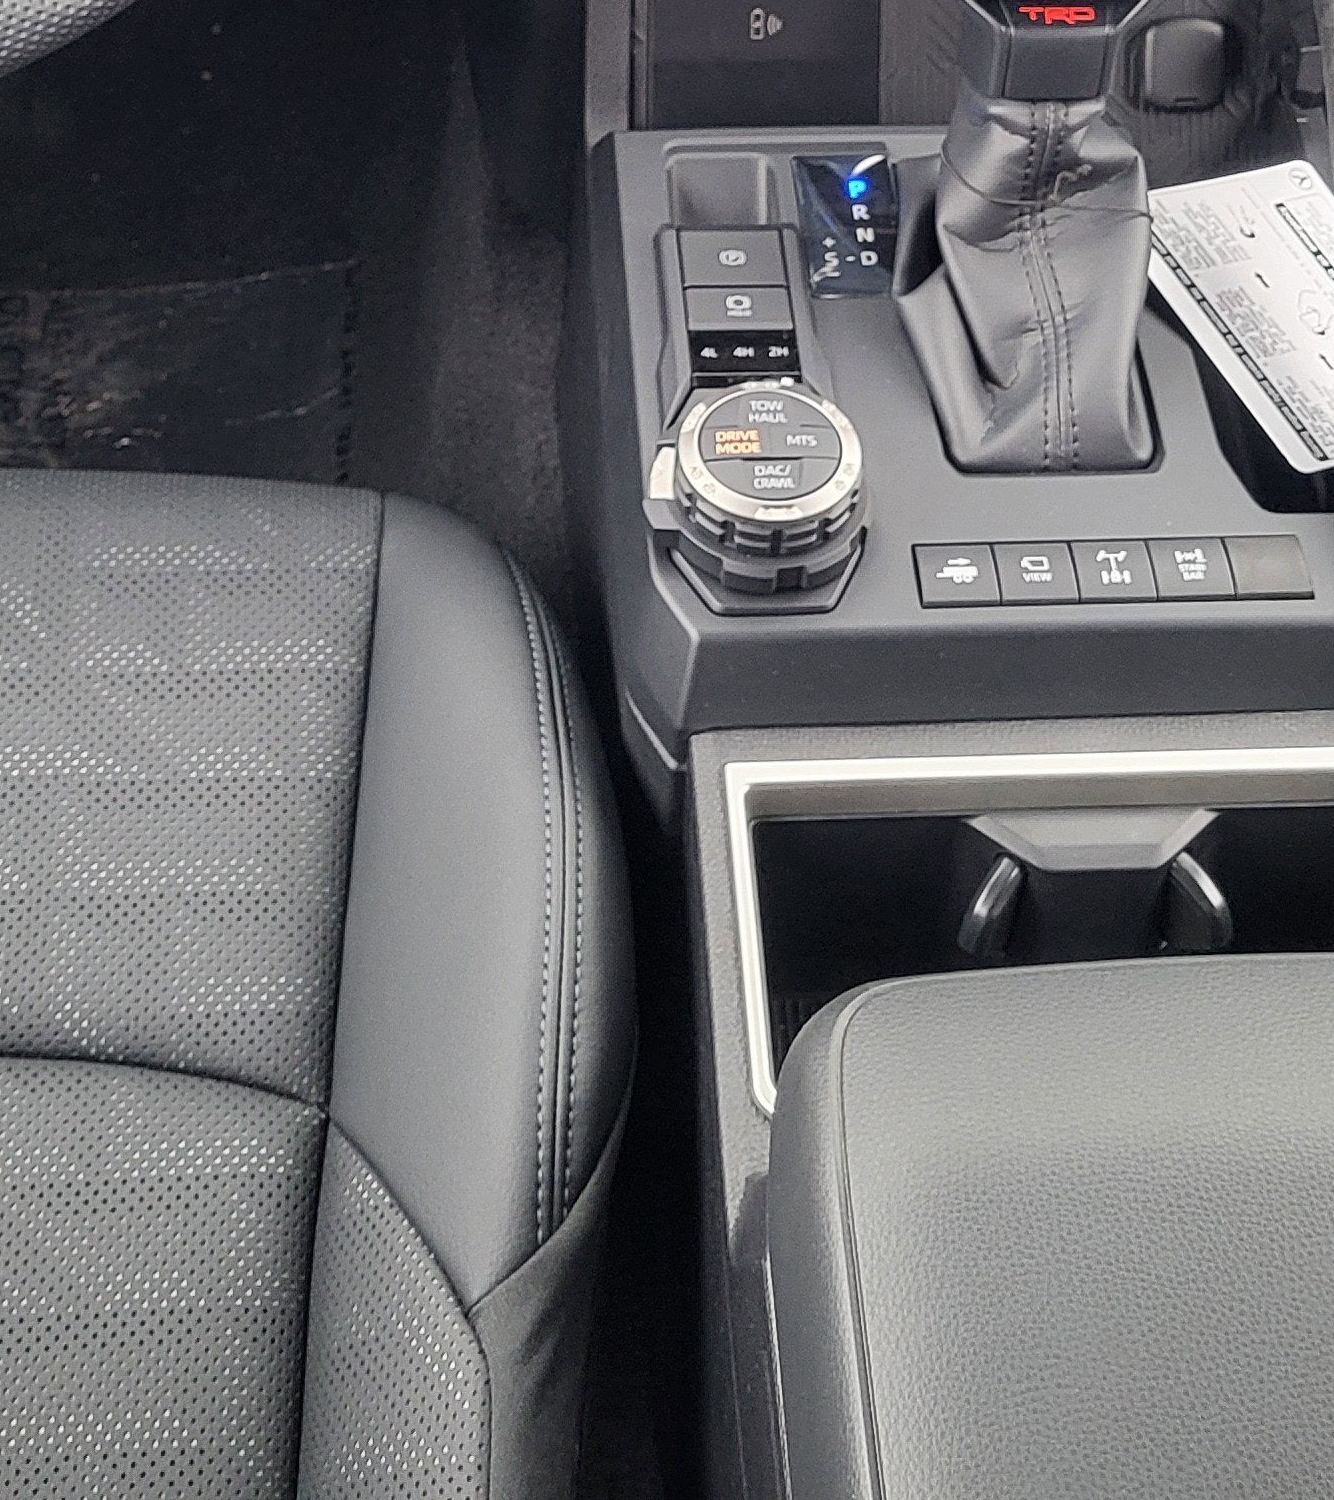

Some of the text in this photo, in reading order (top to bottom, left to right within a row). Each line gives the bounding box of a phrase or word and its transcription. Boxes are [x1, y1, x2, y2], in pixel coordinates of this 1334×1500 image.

[1019, 5, 1097, 25] TRD
[847, 179, 868, 199] P
[851, 203, 872, 220] R
[855, 227, 875, 243] N
[824, 251, 840, 267] S
[860, 250, 879, 267] D
[700, 346, 718, 358] 4L
[748, 400, 785, 412] TOW
[748, 412, 788, 424] HAUL
[714, 429, 760, 442] DRIVE
[786, 434, 818, 447] MTS
[714, 441, 762, 455] MODE
[753, 477, 797, 490] CRAWL
[1021, 572, 1054, 583] VIEW
